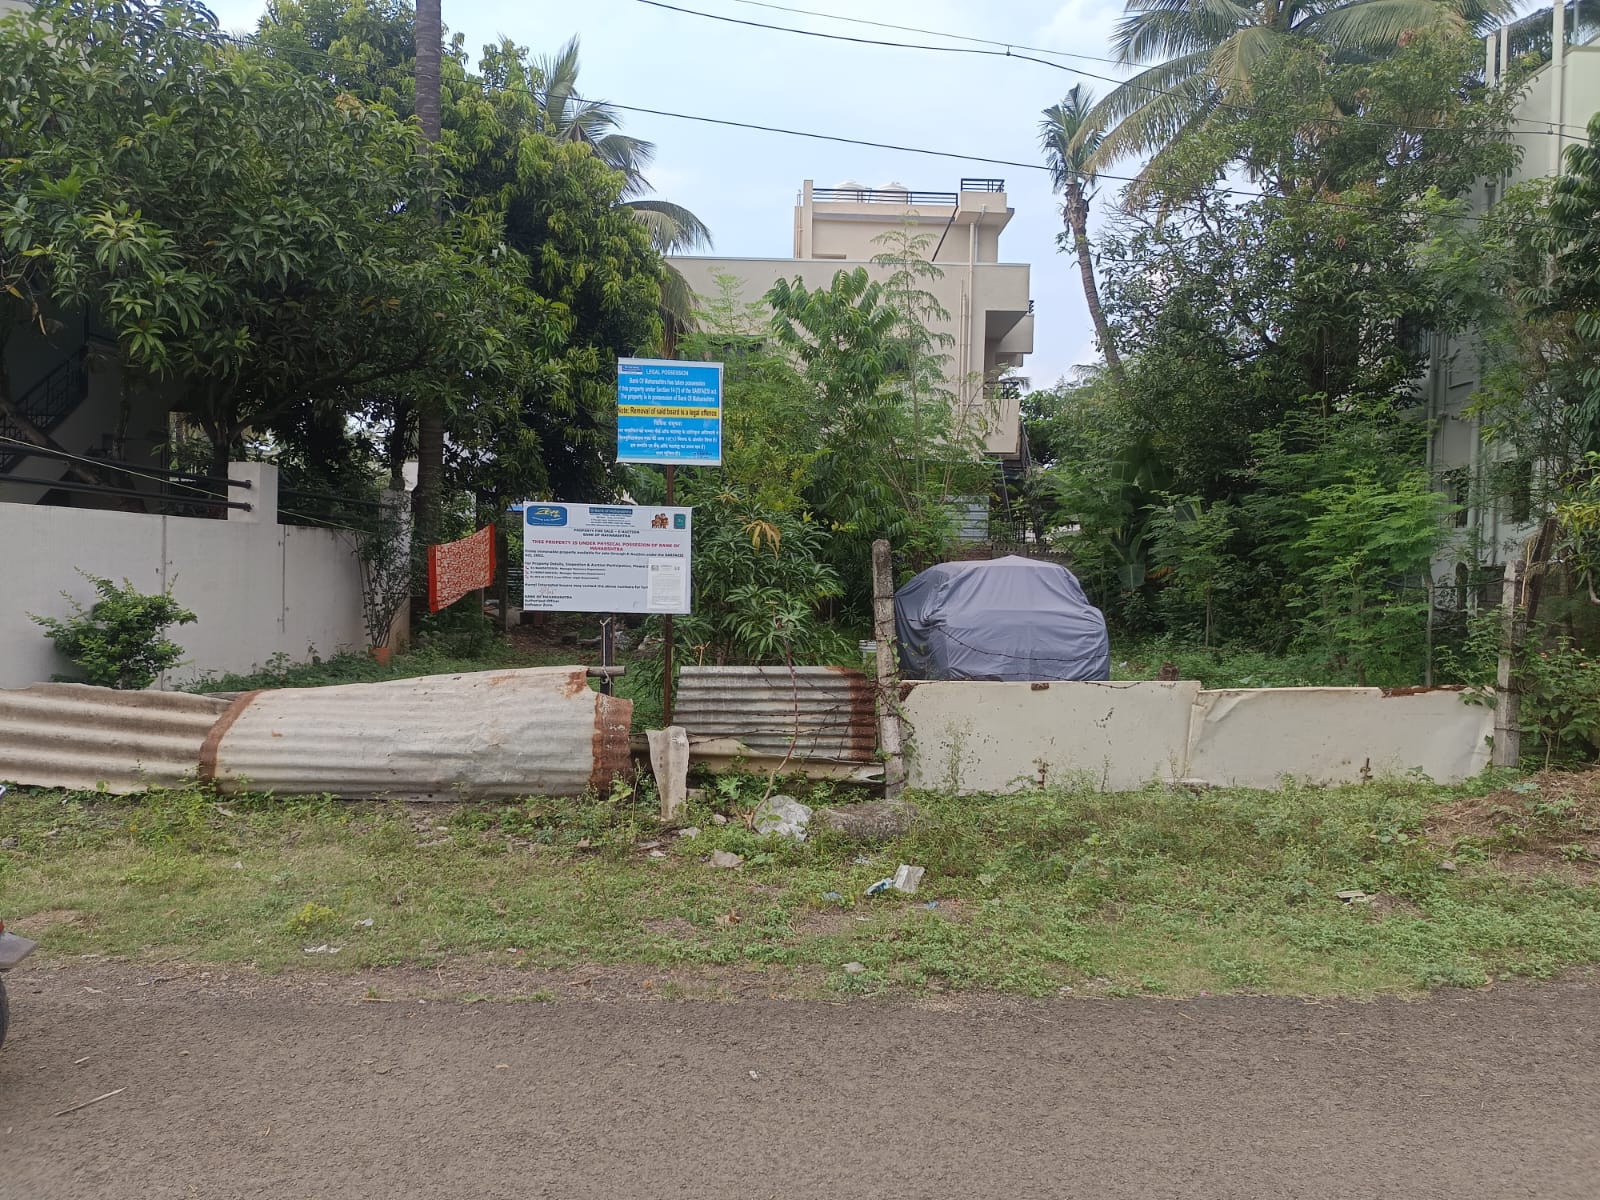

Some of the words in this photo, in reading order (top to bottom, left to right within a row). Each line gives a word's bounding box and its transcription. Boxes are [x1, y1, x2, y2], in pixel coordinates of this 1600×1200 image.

[646, 368, 660, 376] LEGAL
[662, 369, 689, 377] POSSESSION
[630, 406, 650, 414] Removal
[666, 408, 680, 416] board
[690, 410, 700, 418] legal
